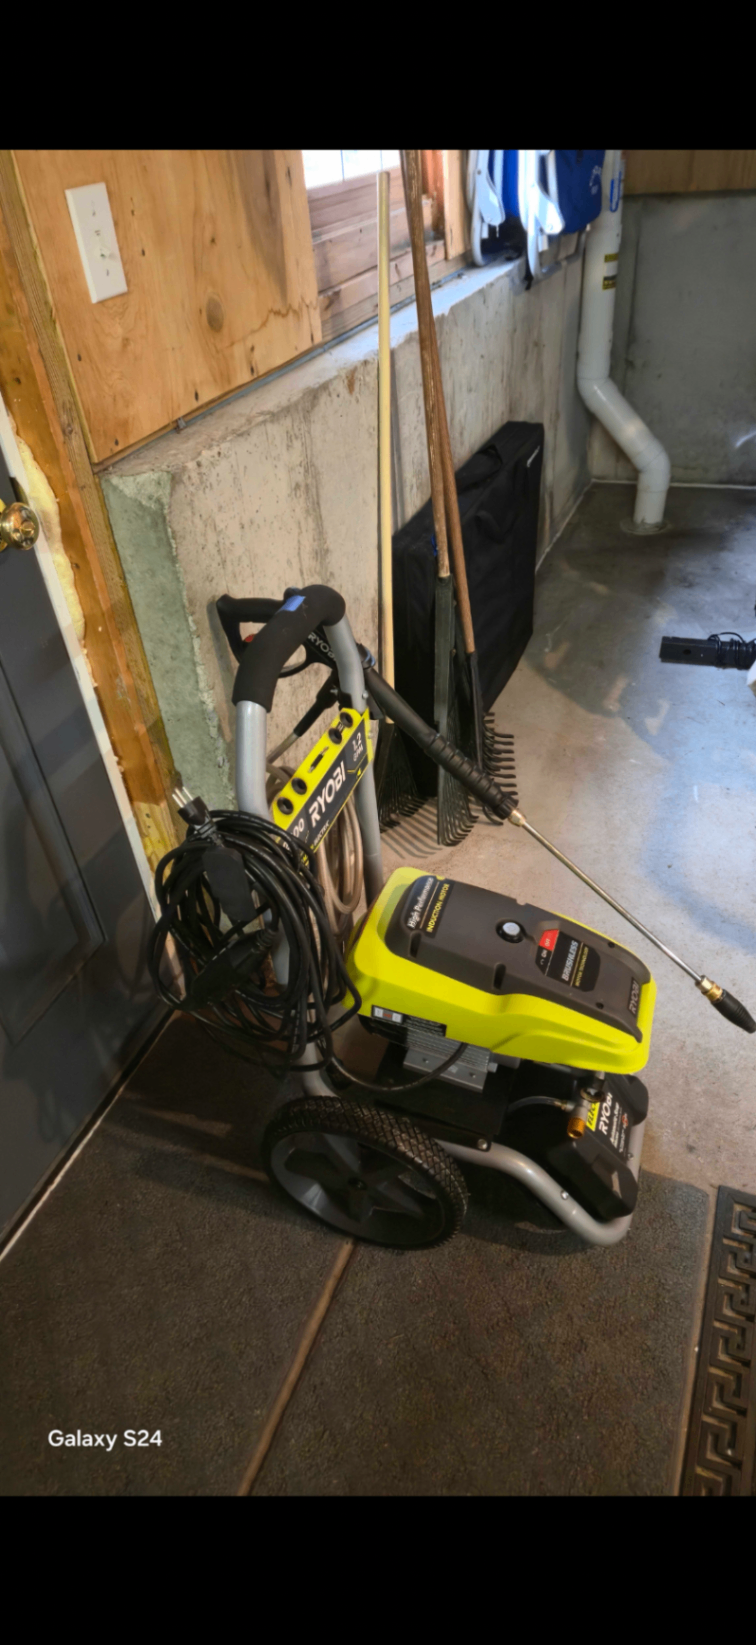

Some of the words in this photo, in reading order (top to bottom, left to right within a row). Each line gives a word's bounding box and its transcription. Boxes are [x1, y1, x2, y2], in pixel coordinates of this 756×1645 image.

[309, 760, 346, 828] RYOBI
[406, 909, 420, 929] High
[413, 876, 435, 912] Performance
[425, 900, 443, 933] INDUCTION
[561, 940, 579, 982] BRUSHLESS
